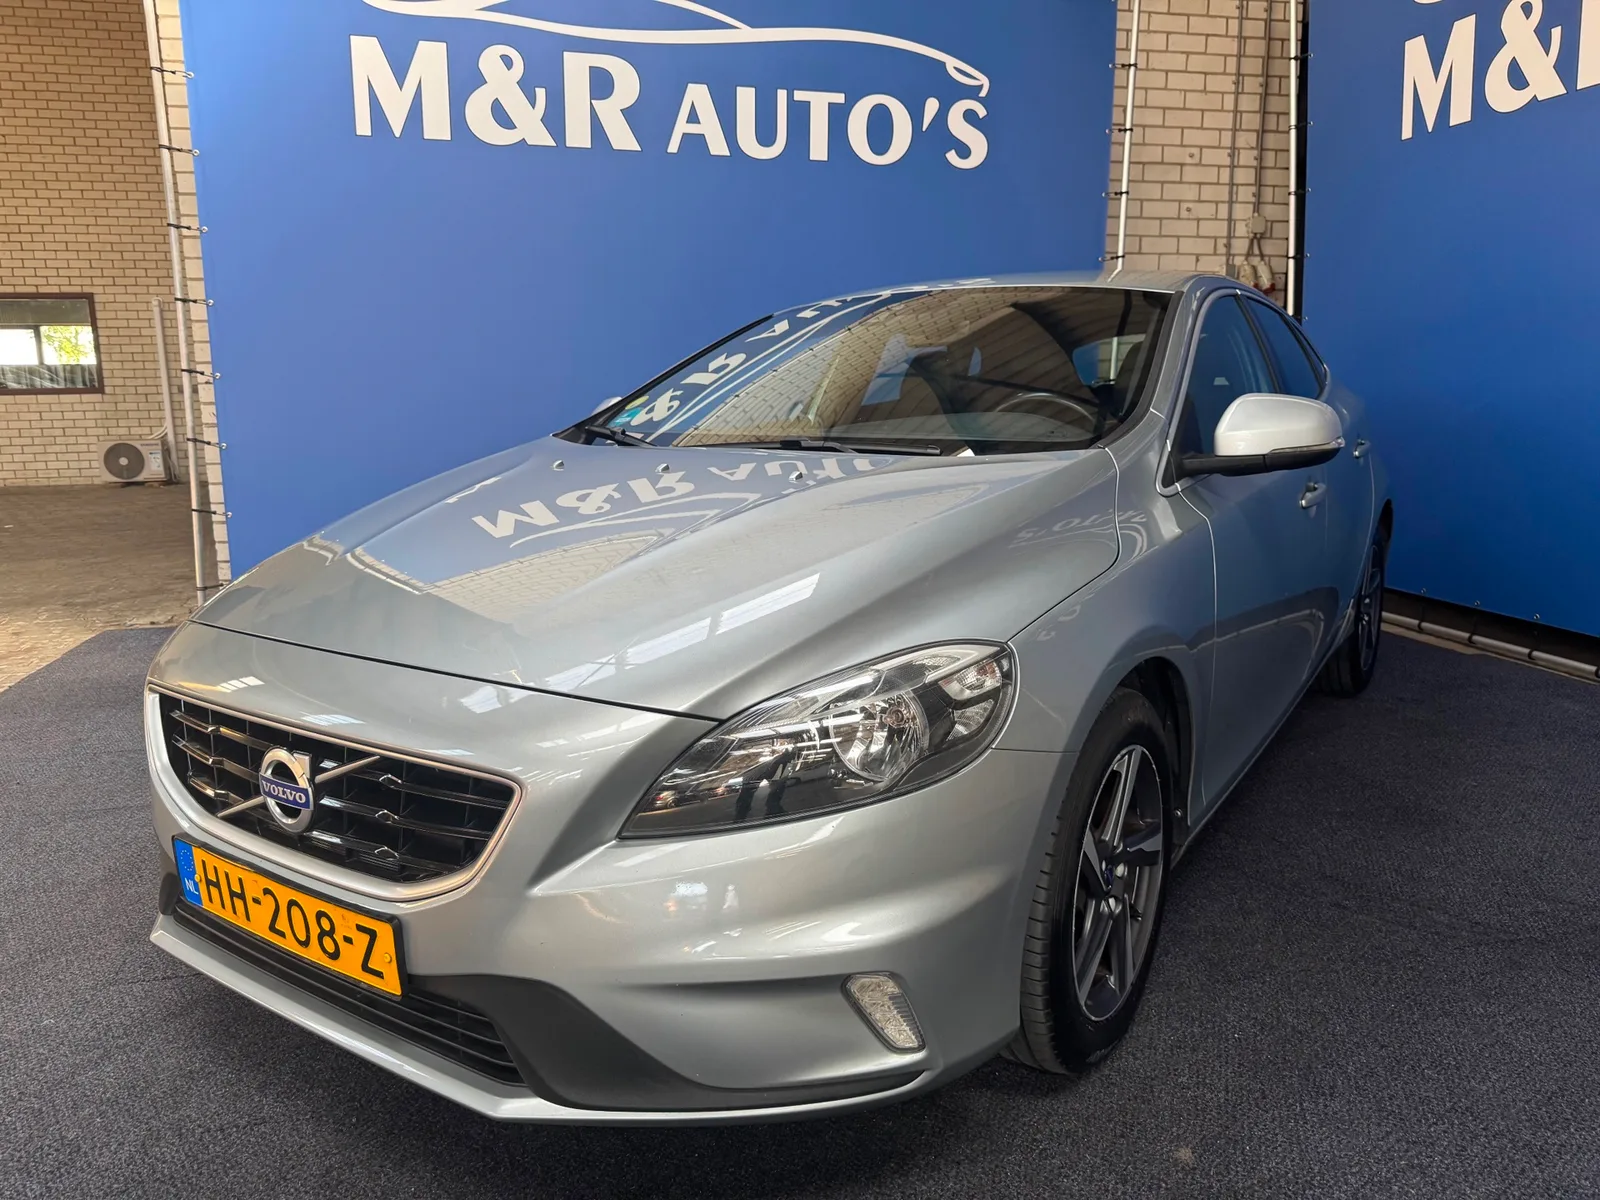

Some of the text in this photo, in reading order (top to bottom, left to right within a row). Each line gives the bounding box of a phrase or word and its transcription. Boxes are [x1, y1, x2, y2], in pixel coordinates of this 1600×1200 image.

[349, 35, 990, 170] M&R AUTO'S
[261, 779, 307, 804] VOLVO
[184, 876, 199, 895] NL
[201, 858, 385, 980] HH-208-Z
